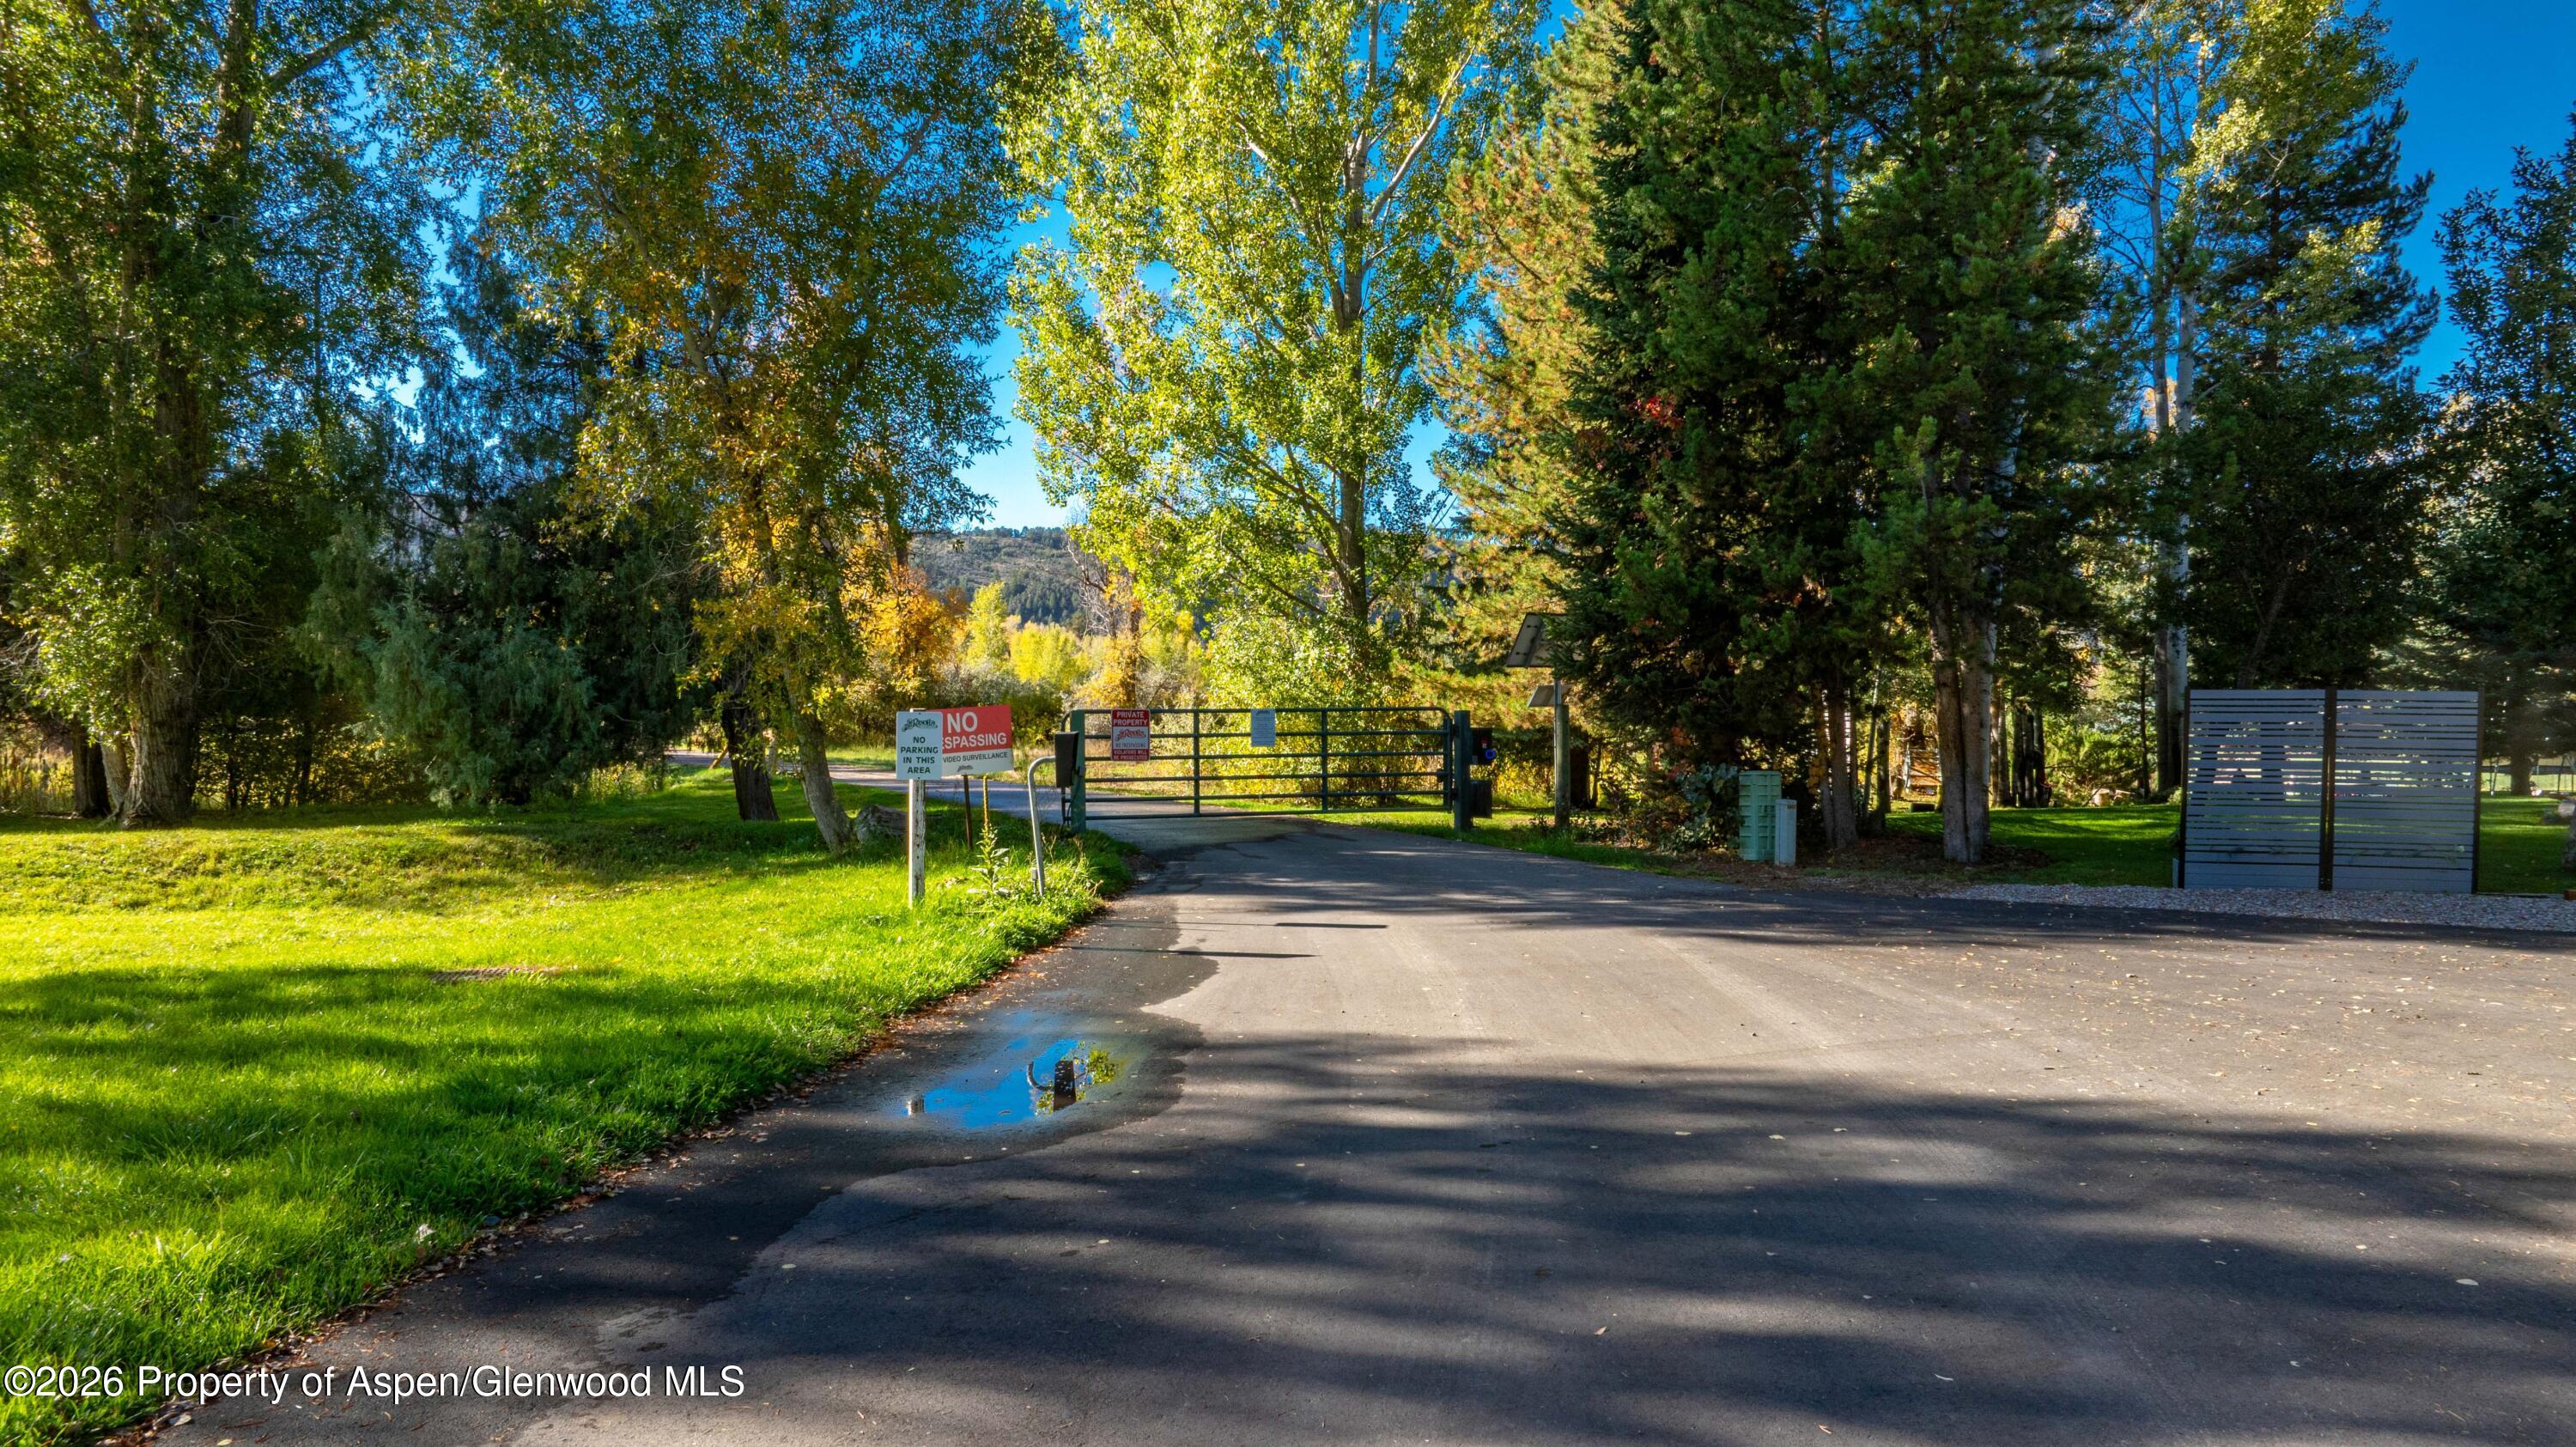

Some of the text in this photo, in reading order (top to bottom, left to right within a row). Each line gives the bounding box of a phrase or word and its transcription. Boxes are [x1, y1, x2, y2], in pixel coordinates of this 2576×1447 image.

[947, 711, 978, 733] NO
[942, 732, 1007, 750] SPASSING
[943, 751, 1009, 763] VIDEO SURVEILLANCE
